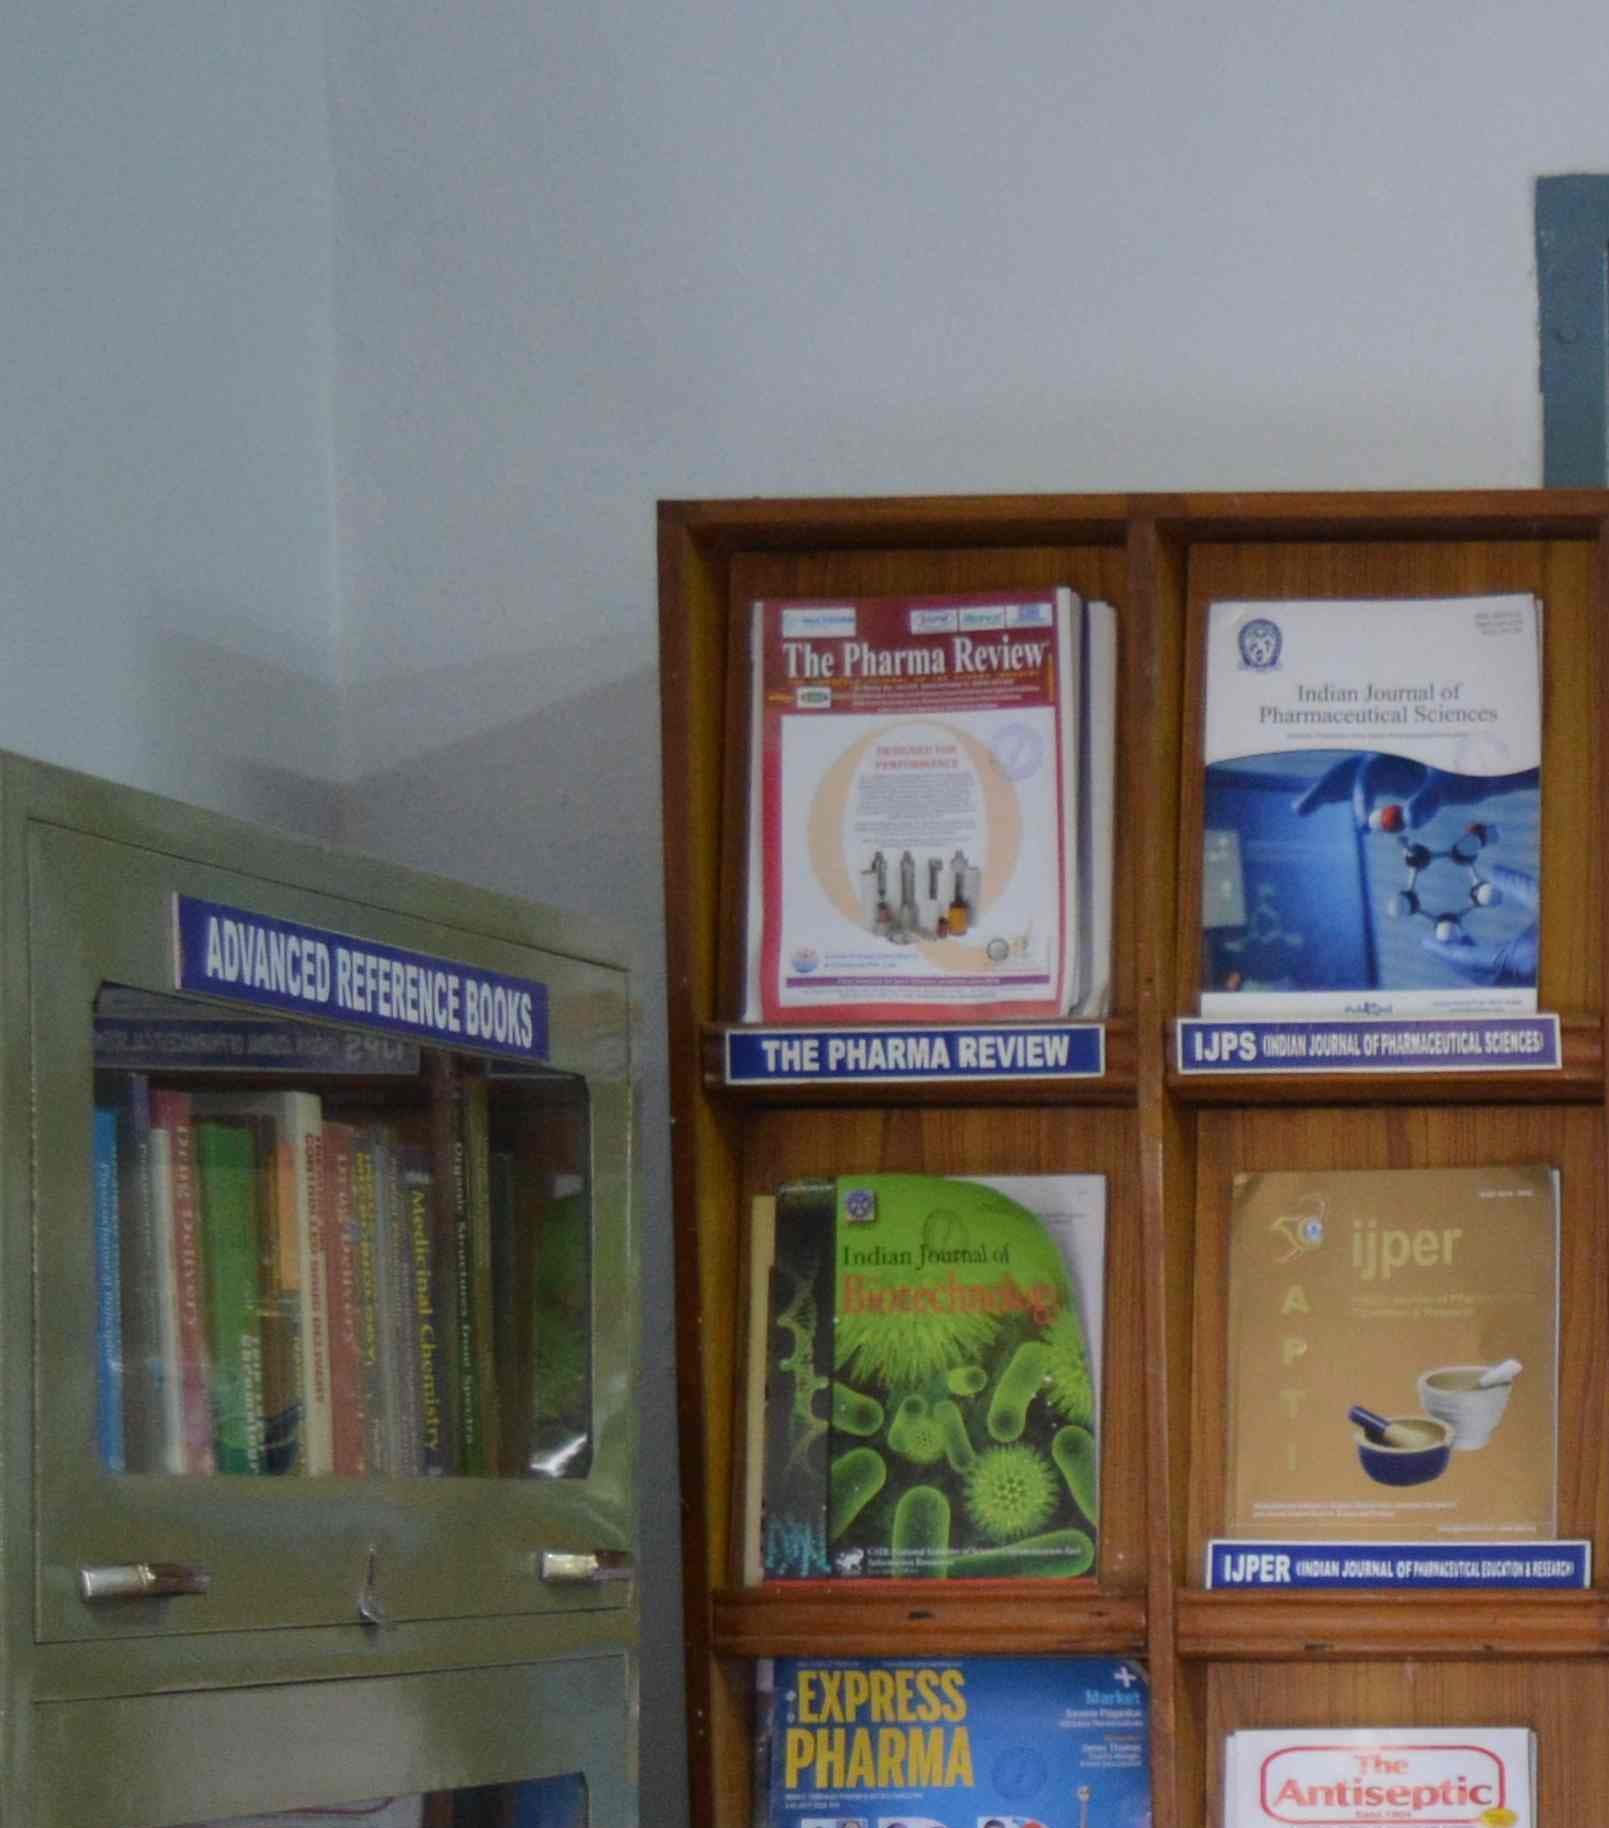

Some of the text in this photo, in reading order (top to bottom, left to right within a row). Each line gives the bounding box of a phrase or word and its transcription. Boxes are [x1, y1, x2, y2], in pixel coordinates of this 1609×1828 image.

[782, 635, 1044, 678] The Pharma Review
[1259, 704, 1499, 725] Pharmaceutical Sciences
[1297, 683, 1464, 703] Indian Journal of
[205, 915, 330, 1004] ADVANCED
[336, 947, 461, 1033] REFERENCE
[465, 979, 533, 1049] BOOKS
[761, 1035, 1070, 1072] THE PHARMA REVIEW
[1194, 1030, 1257, 1063] IJPS
[1263, 1034, 1307, 1058] (INDIAN
[1309, 1034, 1361, 1057] JOURNAL
[1363, 1034, 1380, 1056] OF
[1380, 1031, 1481, 1056] PHARMACEUTICAL
[1351, 1217, 1464, 1280] ijper
[411, 1190, 440, 1450] Medicinal Chemistry
[798, 1669, 968, 1724] EXPRESS
[785, 1727, 975, 1789] PHARMA
[1273, 1775, 1493, 1810] Antiseptic
